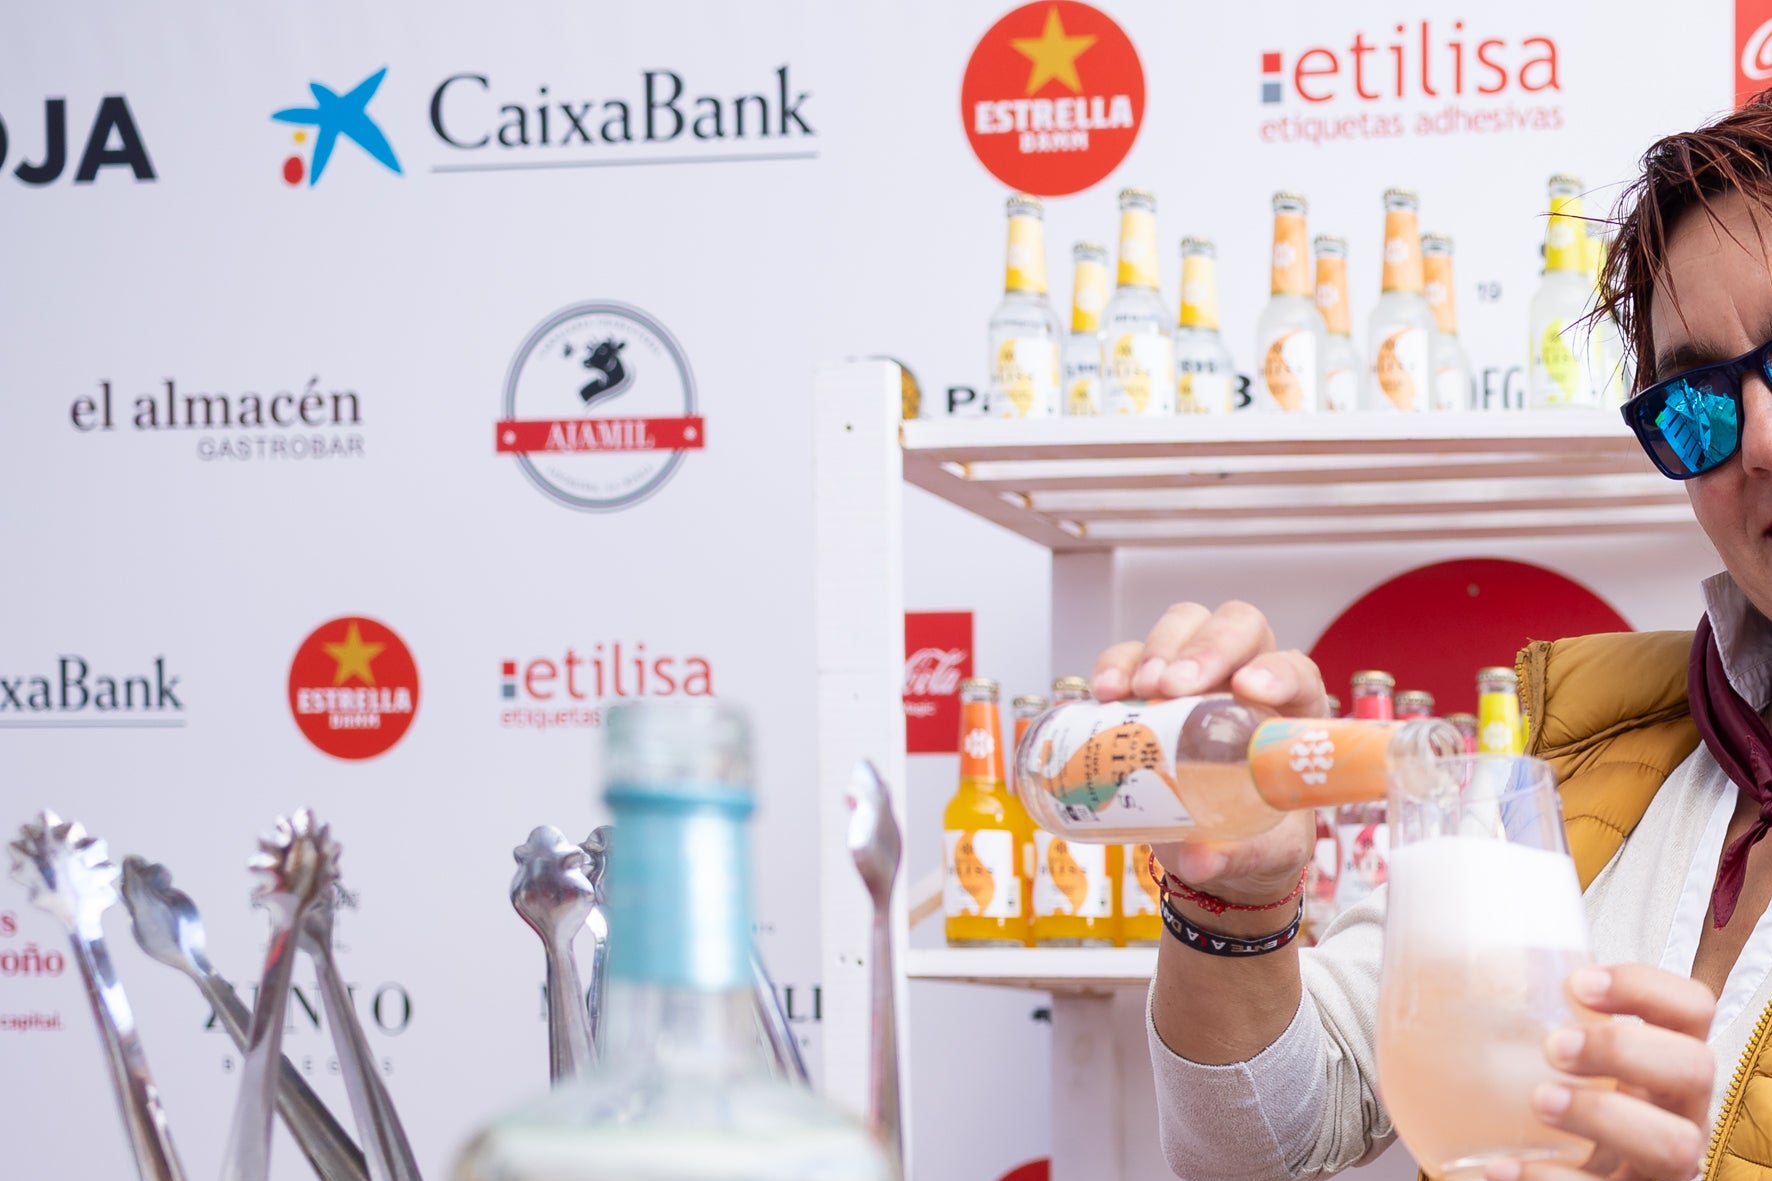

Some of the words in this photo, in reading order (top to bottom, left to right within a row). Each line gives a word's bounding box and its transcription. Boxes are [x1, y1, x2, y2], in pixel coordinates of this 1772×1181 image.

[1294, 21, 1562, 104] etilisa
[429, 66, 818, 150] CaixaBank
[975, 96, 1134, 134] ESTRELLA
[1259, 107, 1406, 143] etiquetas
[1414, 104, 1563, 135] adhesivas
[70, 381, 114, 432] el
[133, 375, 362, 431] almacén
[197, 436, 365, 461] GASTROBAR
[524, 641, 715, 699] etilisa
[298, 687, 411, 714] ESTRELLA
